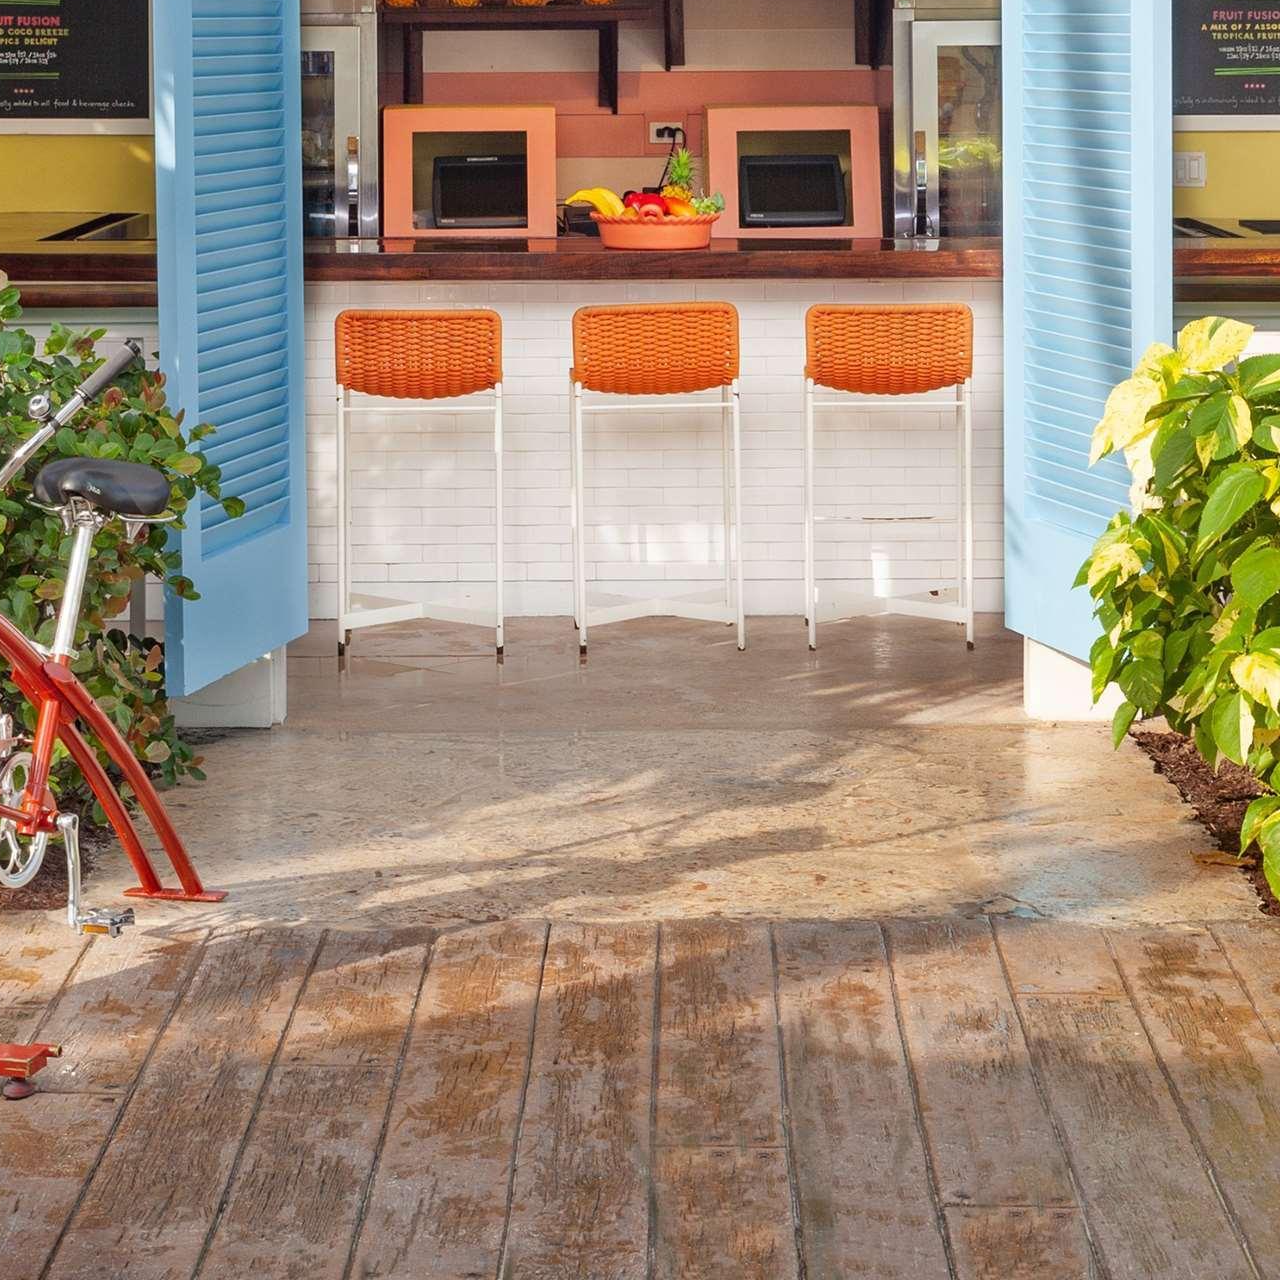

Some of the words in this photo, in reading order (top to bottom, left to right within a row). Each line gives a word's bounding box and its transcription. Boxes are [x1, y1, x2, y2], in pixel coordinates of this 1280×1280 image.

[17, 15, 61, 26] FUSION
[1212, 10, 1244, 21] FRUIT
[7, 27, 33, 36] COCO
[1201, 23, 1208, 31] A
[1210, 23, 1228, 31] MIX
[1230, 23, 1242, 31] OF
[1211, 32, 1255, 40] TROPICAL
[53, 98, 70, 109] food
